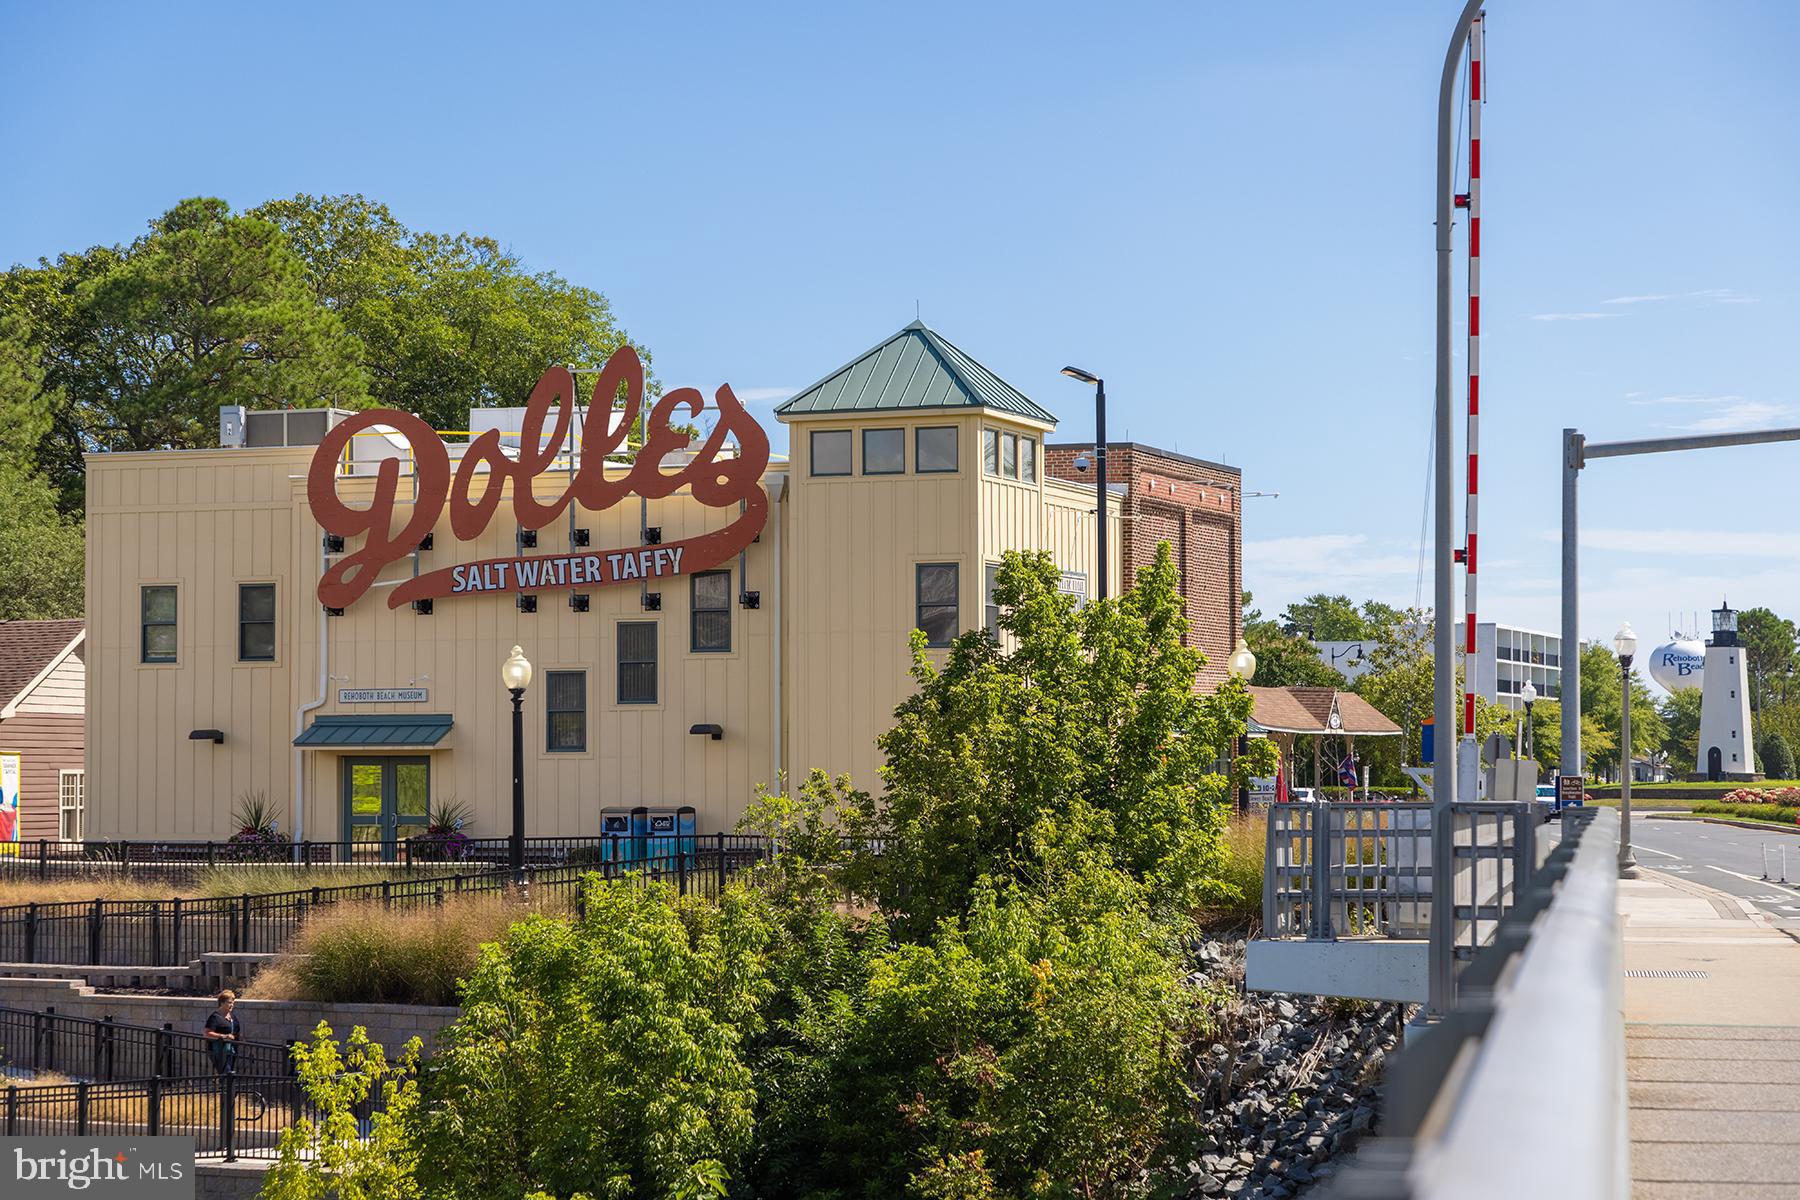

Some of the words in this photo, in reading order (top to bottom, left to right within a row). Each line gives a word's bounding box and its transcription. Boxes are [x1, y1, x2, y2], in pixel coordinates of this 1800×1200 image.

[307, 345, 770, 610] Dolles
[452, 561, 509, 593] SALT
[514, 555, 602, 588] WATER
[607, 546, 684, 582] TAFFY
[1678, 662, 1705, 676] Beac
[343, 691, 374, 700] REHOBOTH
[376, 691, 395, 700] BEACH
[398, 690, 423, 700] MUSEUM
